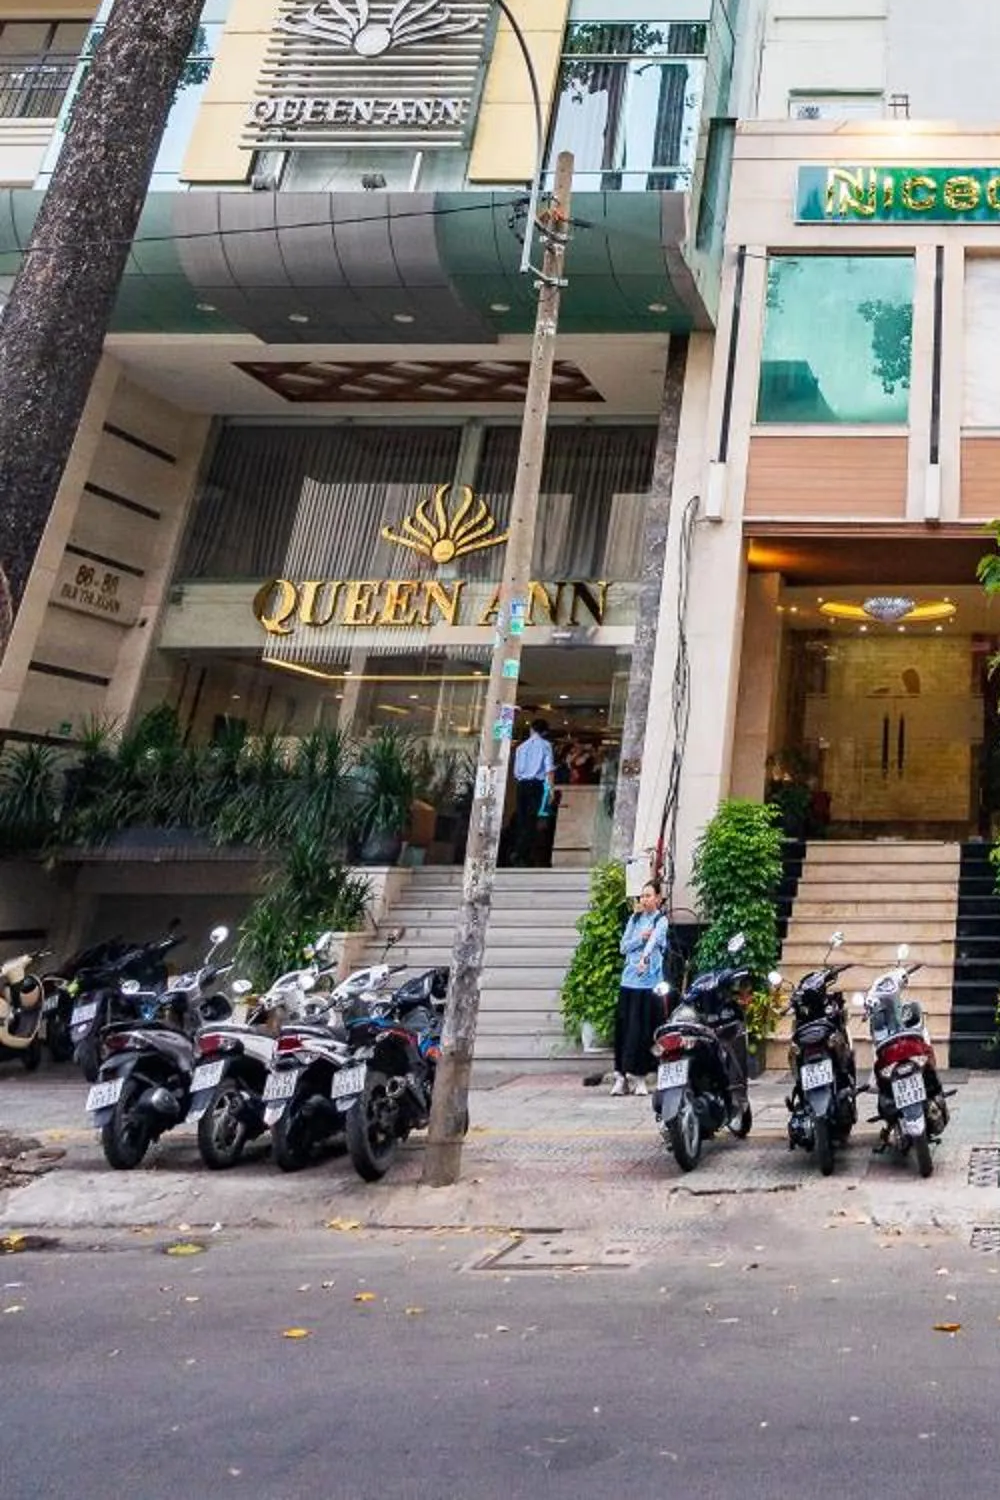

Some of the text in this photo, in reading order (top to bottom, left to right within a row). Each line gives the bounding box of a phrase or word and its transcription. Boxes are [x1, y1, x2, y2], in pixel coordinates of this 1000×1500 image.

[251, 98, 470, 125] QUEEN ANN
[253, 579, 466, 635] QUEEN
